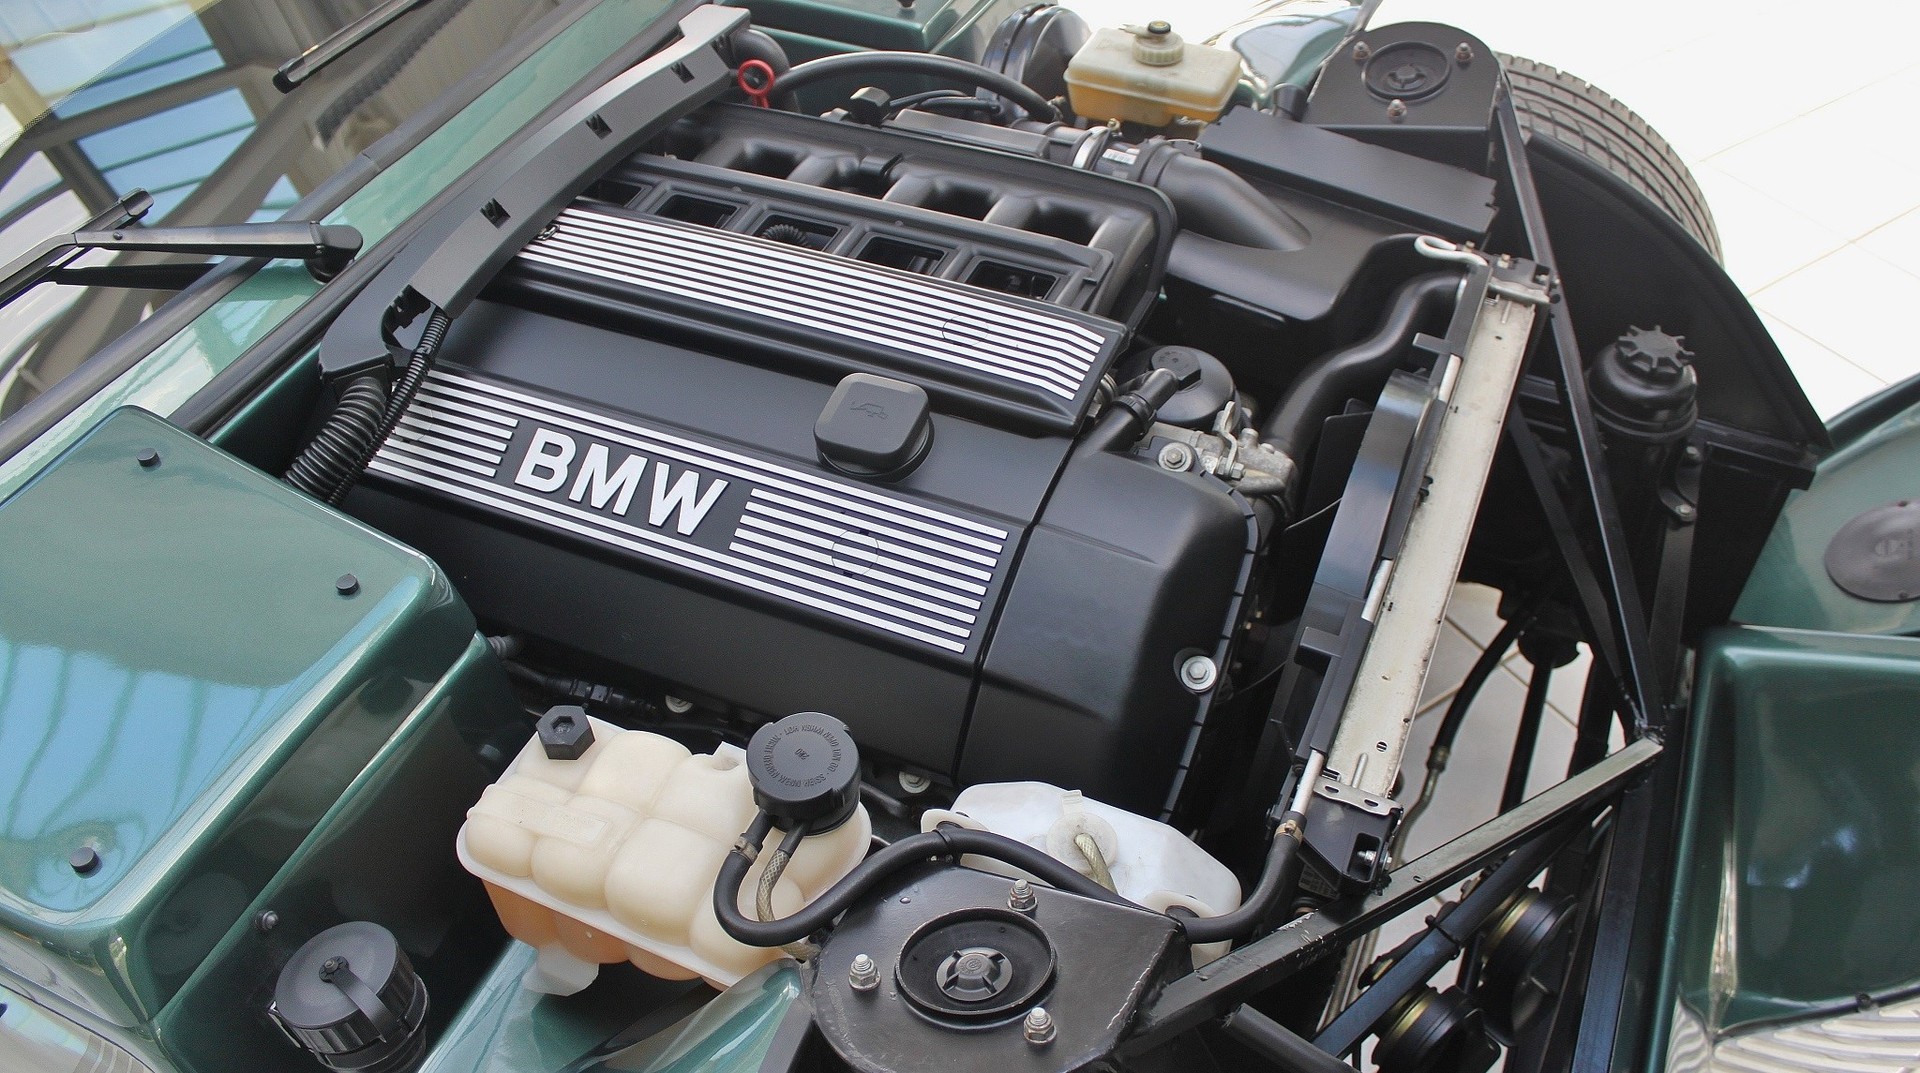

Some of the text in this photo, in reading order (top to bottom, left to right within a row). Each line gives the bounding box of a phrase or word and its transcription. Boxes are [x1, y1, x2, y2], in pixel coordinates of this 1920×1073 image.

[514, 427, 730, 536] BMW
[784, 725, 799, 735] HOT
[801, 724, 825, 735] WHEN
[824, 731, 839, 747] OPEN
[827, 762, 838, 772] DO
[778, 774, 801, 788] WENN
[803, 773, 826, 787] HEISS
